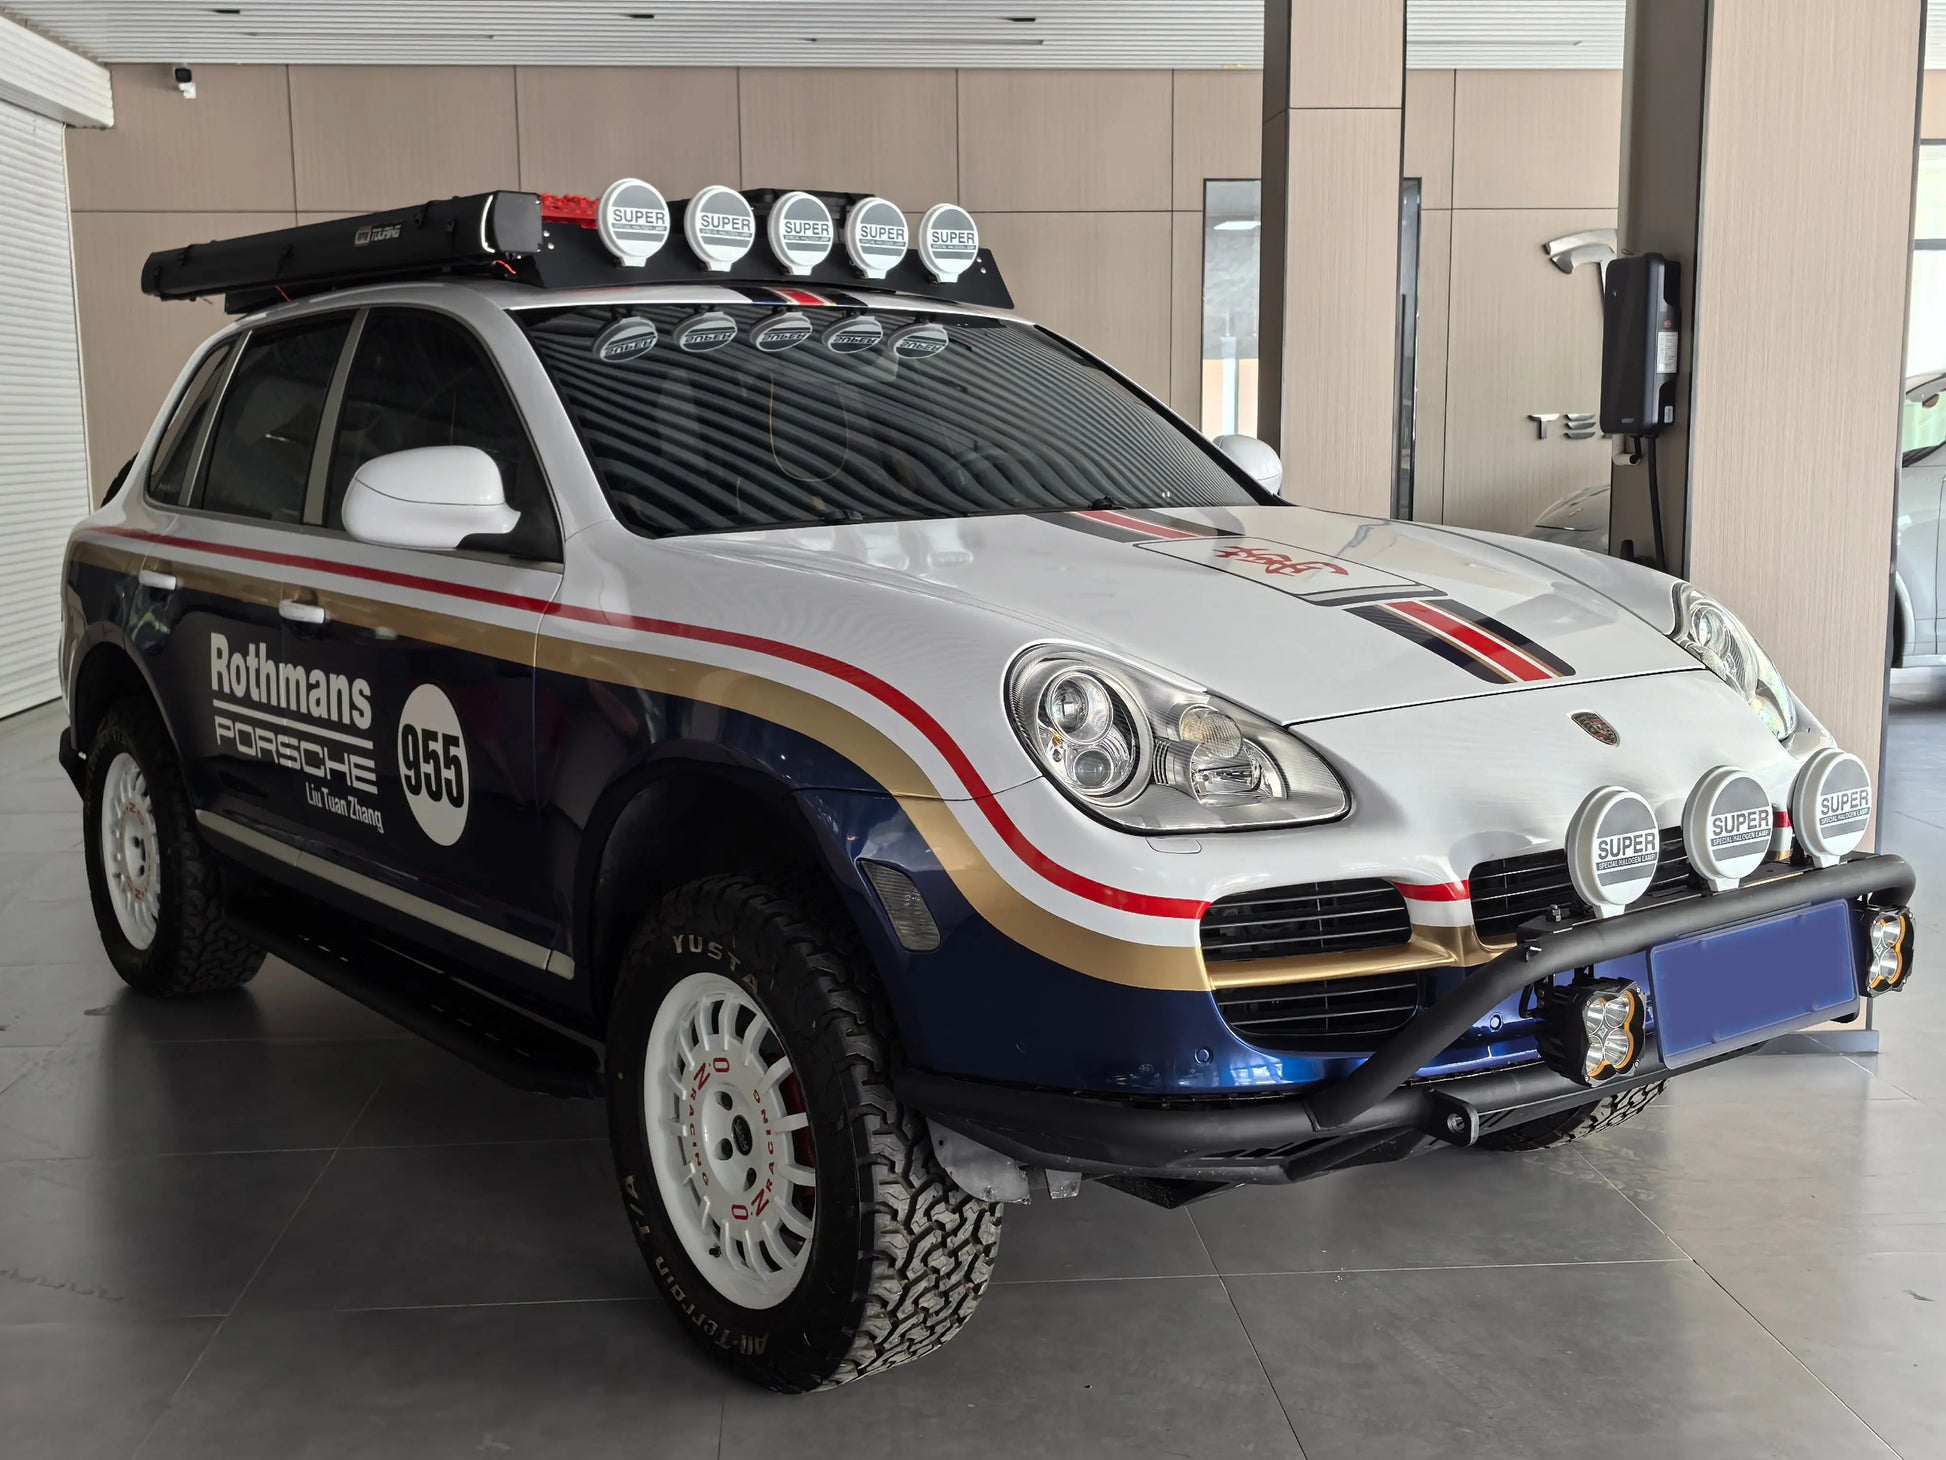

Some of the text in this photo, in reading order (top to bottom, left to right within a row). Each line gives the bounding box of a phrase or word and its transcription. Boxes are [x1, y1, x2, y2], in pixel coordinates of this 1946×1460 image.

[613, 208, 665, 224] SUPER
[701, 214, 751, 231] SUPER
[784, 221, 829, 235] SUPER
[860, 225, 905, 240] SUPER
[931, 231, 975, 244] SUPER
[210, 632, 373, 731] Rothmans
[214, 715, 378, 795] PORSCHE
[401, 723, 465, 809] 955
[305, 782, 385, 834] Liu Tuan Zhang
[1821, 789, 1869, 815] SUPER
[1712, 809, 1769, 837] SUPER
[1598, 832, 1656, 860] SUPER
[1712, 836, 1733, 846] SPECIAL
[1598, 853, 1656, 870] SPECIAL HALOGEN LAMP
[672, 934, 758, 995] YUSTA
[688, 1088, 710, 1186] RACING
[752, 1089, 775, 1193] RACING
[655, 1254, 770, 1356] All-Terrain
